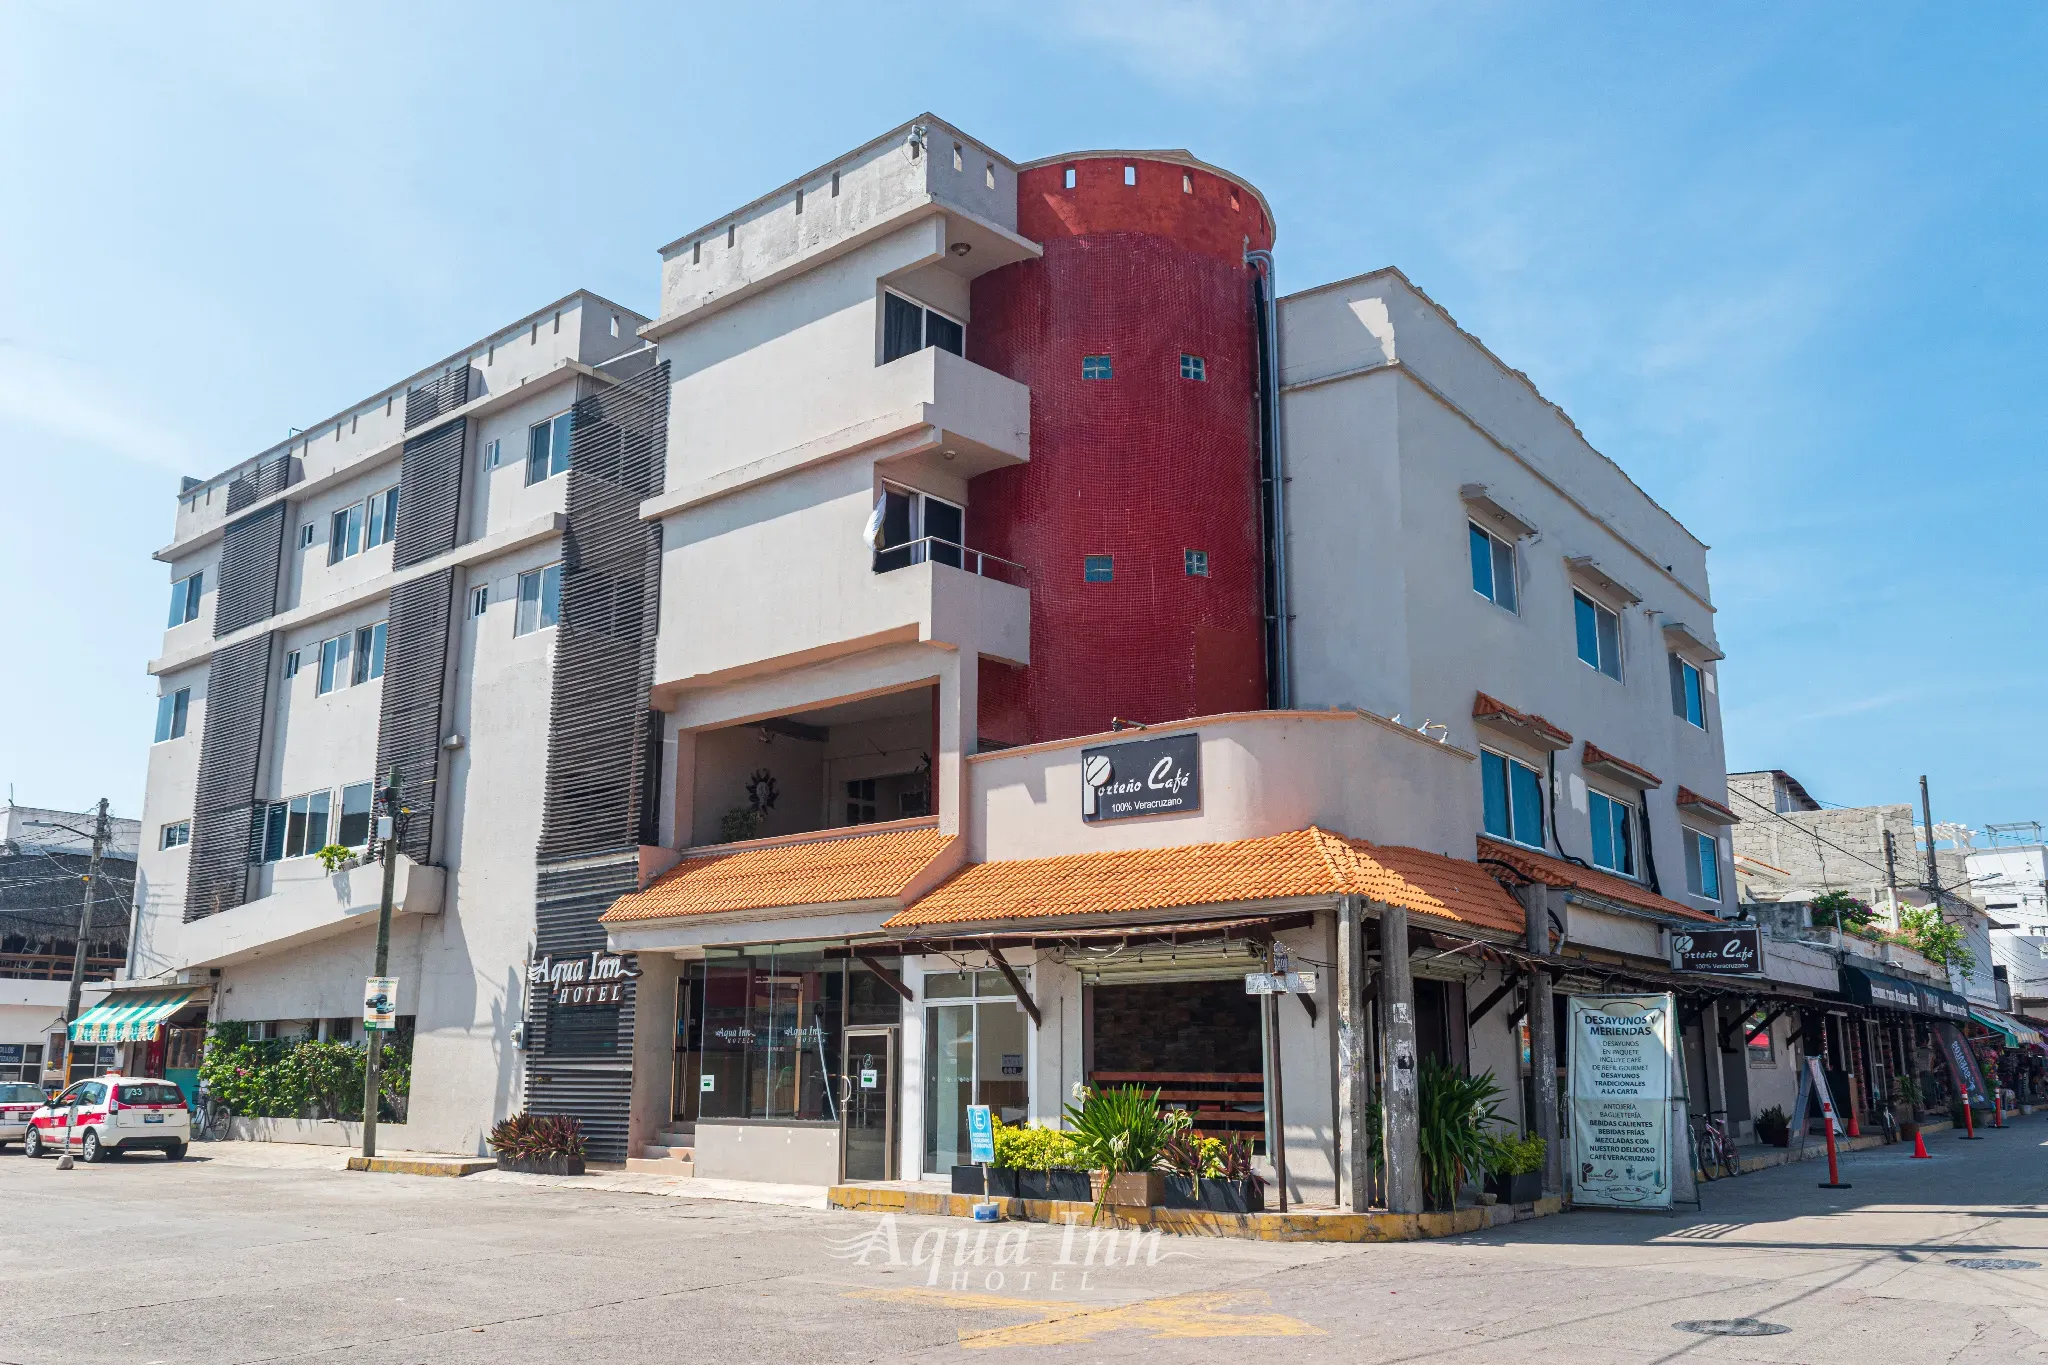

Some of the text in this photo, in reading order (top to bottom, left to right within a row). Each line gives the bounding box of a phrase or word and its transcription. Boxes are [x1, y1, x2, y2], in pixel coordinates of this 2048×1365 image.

[1084, 756, 1190, 814] Porteño Café
[1112, 798, 1182, 812] 100% Veracruzano
[1722, 939, 1754, 961] Café
[535, 952, 622, 990] Aqua Inn
[559, 986, 621, 1004] HOTEL
[1584, 1015, 1656, 1025] DESAYUNOS Y
[718, 1027, 737, 1039] Aqua
[1590, 1027, 1652, 1036] MERIENDAS
[132, 1088, 143, 1096] 33
[1599, 1111, 1642, 1119] BAGUETTERÍA
[1589, 1119, 1653, 1128] BEBIDAS CALIENTES
[1598, 1128, 1645, 1136] BEBIDAS FRÍAS
[1621, 1146, 1656, 1154] DELICIOSO
[1607, 1154, 1656, 1162] VERACRUZANO
